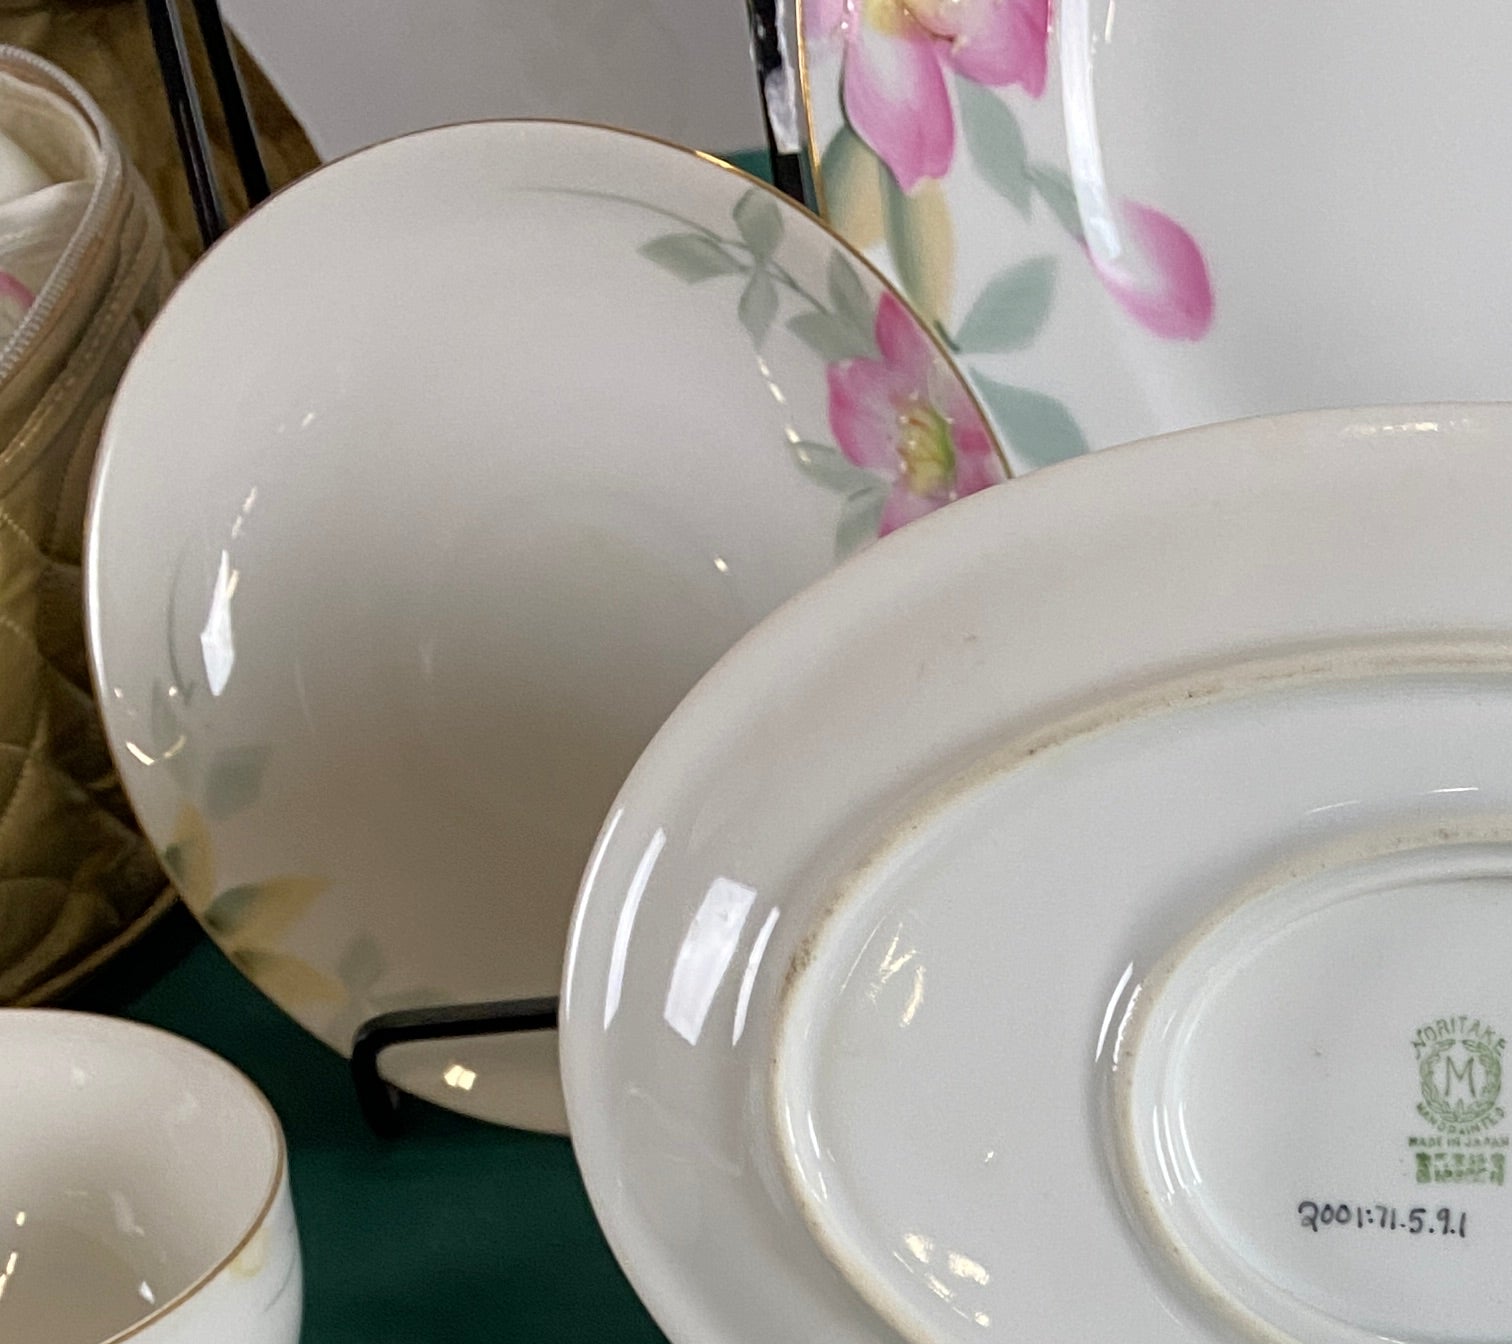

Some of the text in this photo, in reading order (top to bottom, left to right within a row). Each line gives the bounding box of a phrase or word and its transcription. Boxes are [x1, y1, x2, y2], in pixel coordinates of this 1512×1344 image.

[1411, 1015, 1508, 1060] NORITAKE
[1444, 1055, 1477, 1098] M
[1408, 1136, 1510, 1148] MADE IN JAPAN
